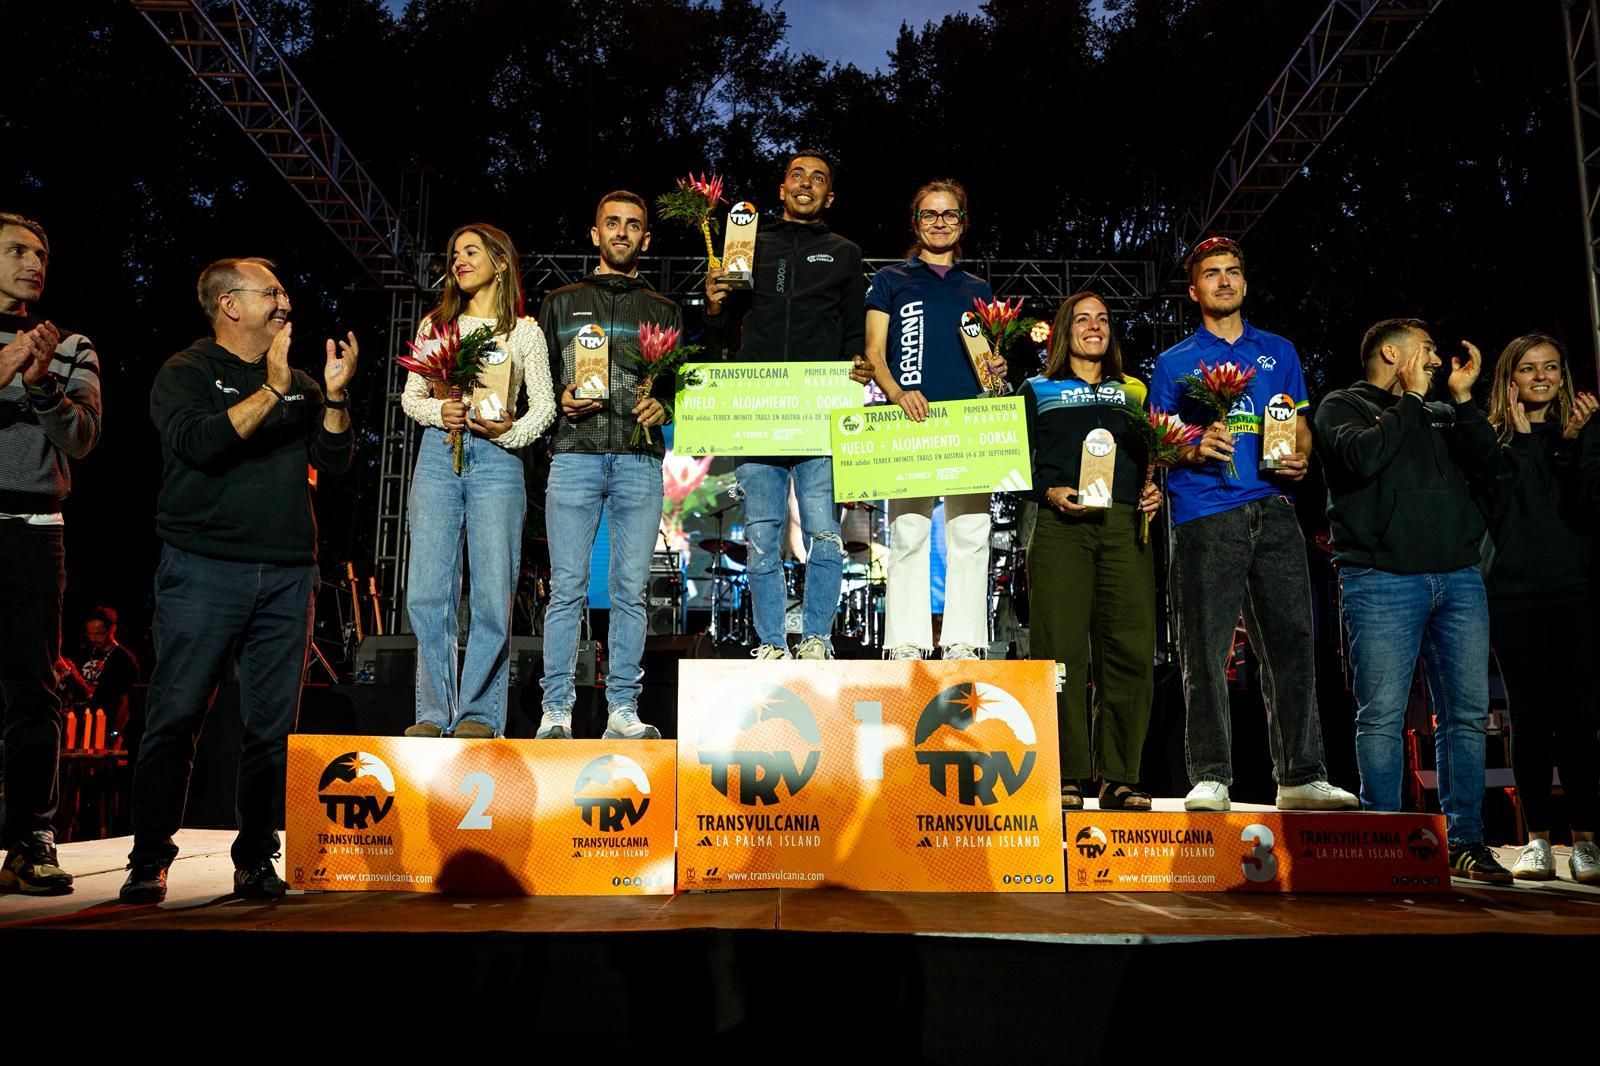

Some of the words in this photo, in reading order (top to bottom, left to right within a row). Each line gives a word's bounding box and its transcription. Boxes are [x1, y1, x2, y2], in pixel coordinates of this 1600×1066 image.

[731, 213, 755, 225] TRV
[900, 301, 924, 386] BAYANA
[709, 367, 789, 380] TRANSVULCANIA
[804, 367, 827, 376] PRIMER
[829, 367, 852, 376] PALME
[683, 396, 716, 409] VUELO
[732, 395, 799, 412] ALOJAMIENTO
[816, 395, 853, 409] DORSAL
[963, 405, 989, 414] PRIMERA
[991, 403, 1017, 412] PALMERA
[1268, 407, 1295, 420] TRV
[843, 423, 860, 431] TRV
[1229, 424, 1255, 433] FINITA
[840, 440, 874, 456] VUELO
[892, 433, 961, 453] ALOJAMIENTO
[980, 431, 1019, 446] DORSAL
[840, 460, 853, 468] PARA
[873, 457, 892, 465] TERREX
[893, 455, 914, 463] INFINITE
[916, 454, 933, 462] TRAILS
[944, 452, 964, 460] AUSTRIA
[853, 701, 884, 780] 1
[697, 750, 821, 807] TRV
[915, 751, 1037, 807] TRV
[457, 772, 496, 830] 2
[318, 794, 395, 830] TRV
[574, 797, 651, 833] TRV
[697, 814, 820, 832] TRANSVULCANIA
[916, 815, 1039, 832] TRANSVULCANIA
[318, 833, 393, 846] TRANSVULCANIA
[572, 837, 649, 848] TRANSVULCANIA
[715, 835, 729, 847] LA
[735, 835, 773, 847] PALMA
[779, 835, 821, 847] ISLAND
[935, 835, 949, 848] LA
[955, 835, 992, 848] PALMA
[1000, 835, 1040, 848] ISLAND
[1110, 829, 1214, 844] TRANSVULCANIA
[1300, 831, 1402, 846] TRANSVULCANIA
[329, 846, 337, 856] LA
[341, 846, 365, 856] PALMA
[368, 846, 394, 856] ISLAND
[583, 850, 592, 858] LA
[596, 850, 619, 858] PALMA
[623, 850, 649, 858] ISLAND
[1076, 844, 1107, 859] TRV
[1128, 847, 1138, 858] LA
[1144, 847, 1175, 858] PALMA
[1180, 847, 1215, 858] ISLAND
[1240, 823, 1278, 883] 3
[1316, 849, 1327, 859] LA
[1332, 849, 1364, 859] PALMA
[1369, 849, 1403, 859] ISLAND
[336, 872, 433, 884] www.transvulcania.com
[727, 870, 825, 882] www.transvulcania.com
[1118, 872, 1216, 884] www.transvulcania.com
